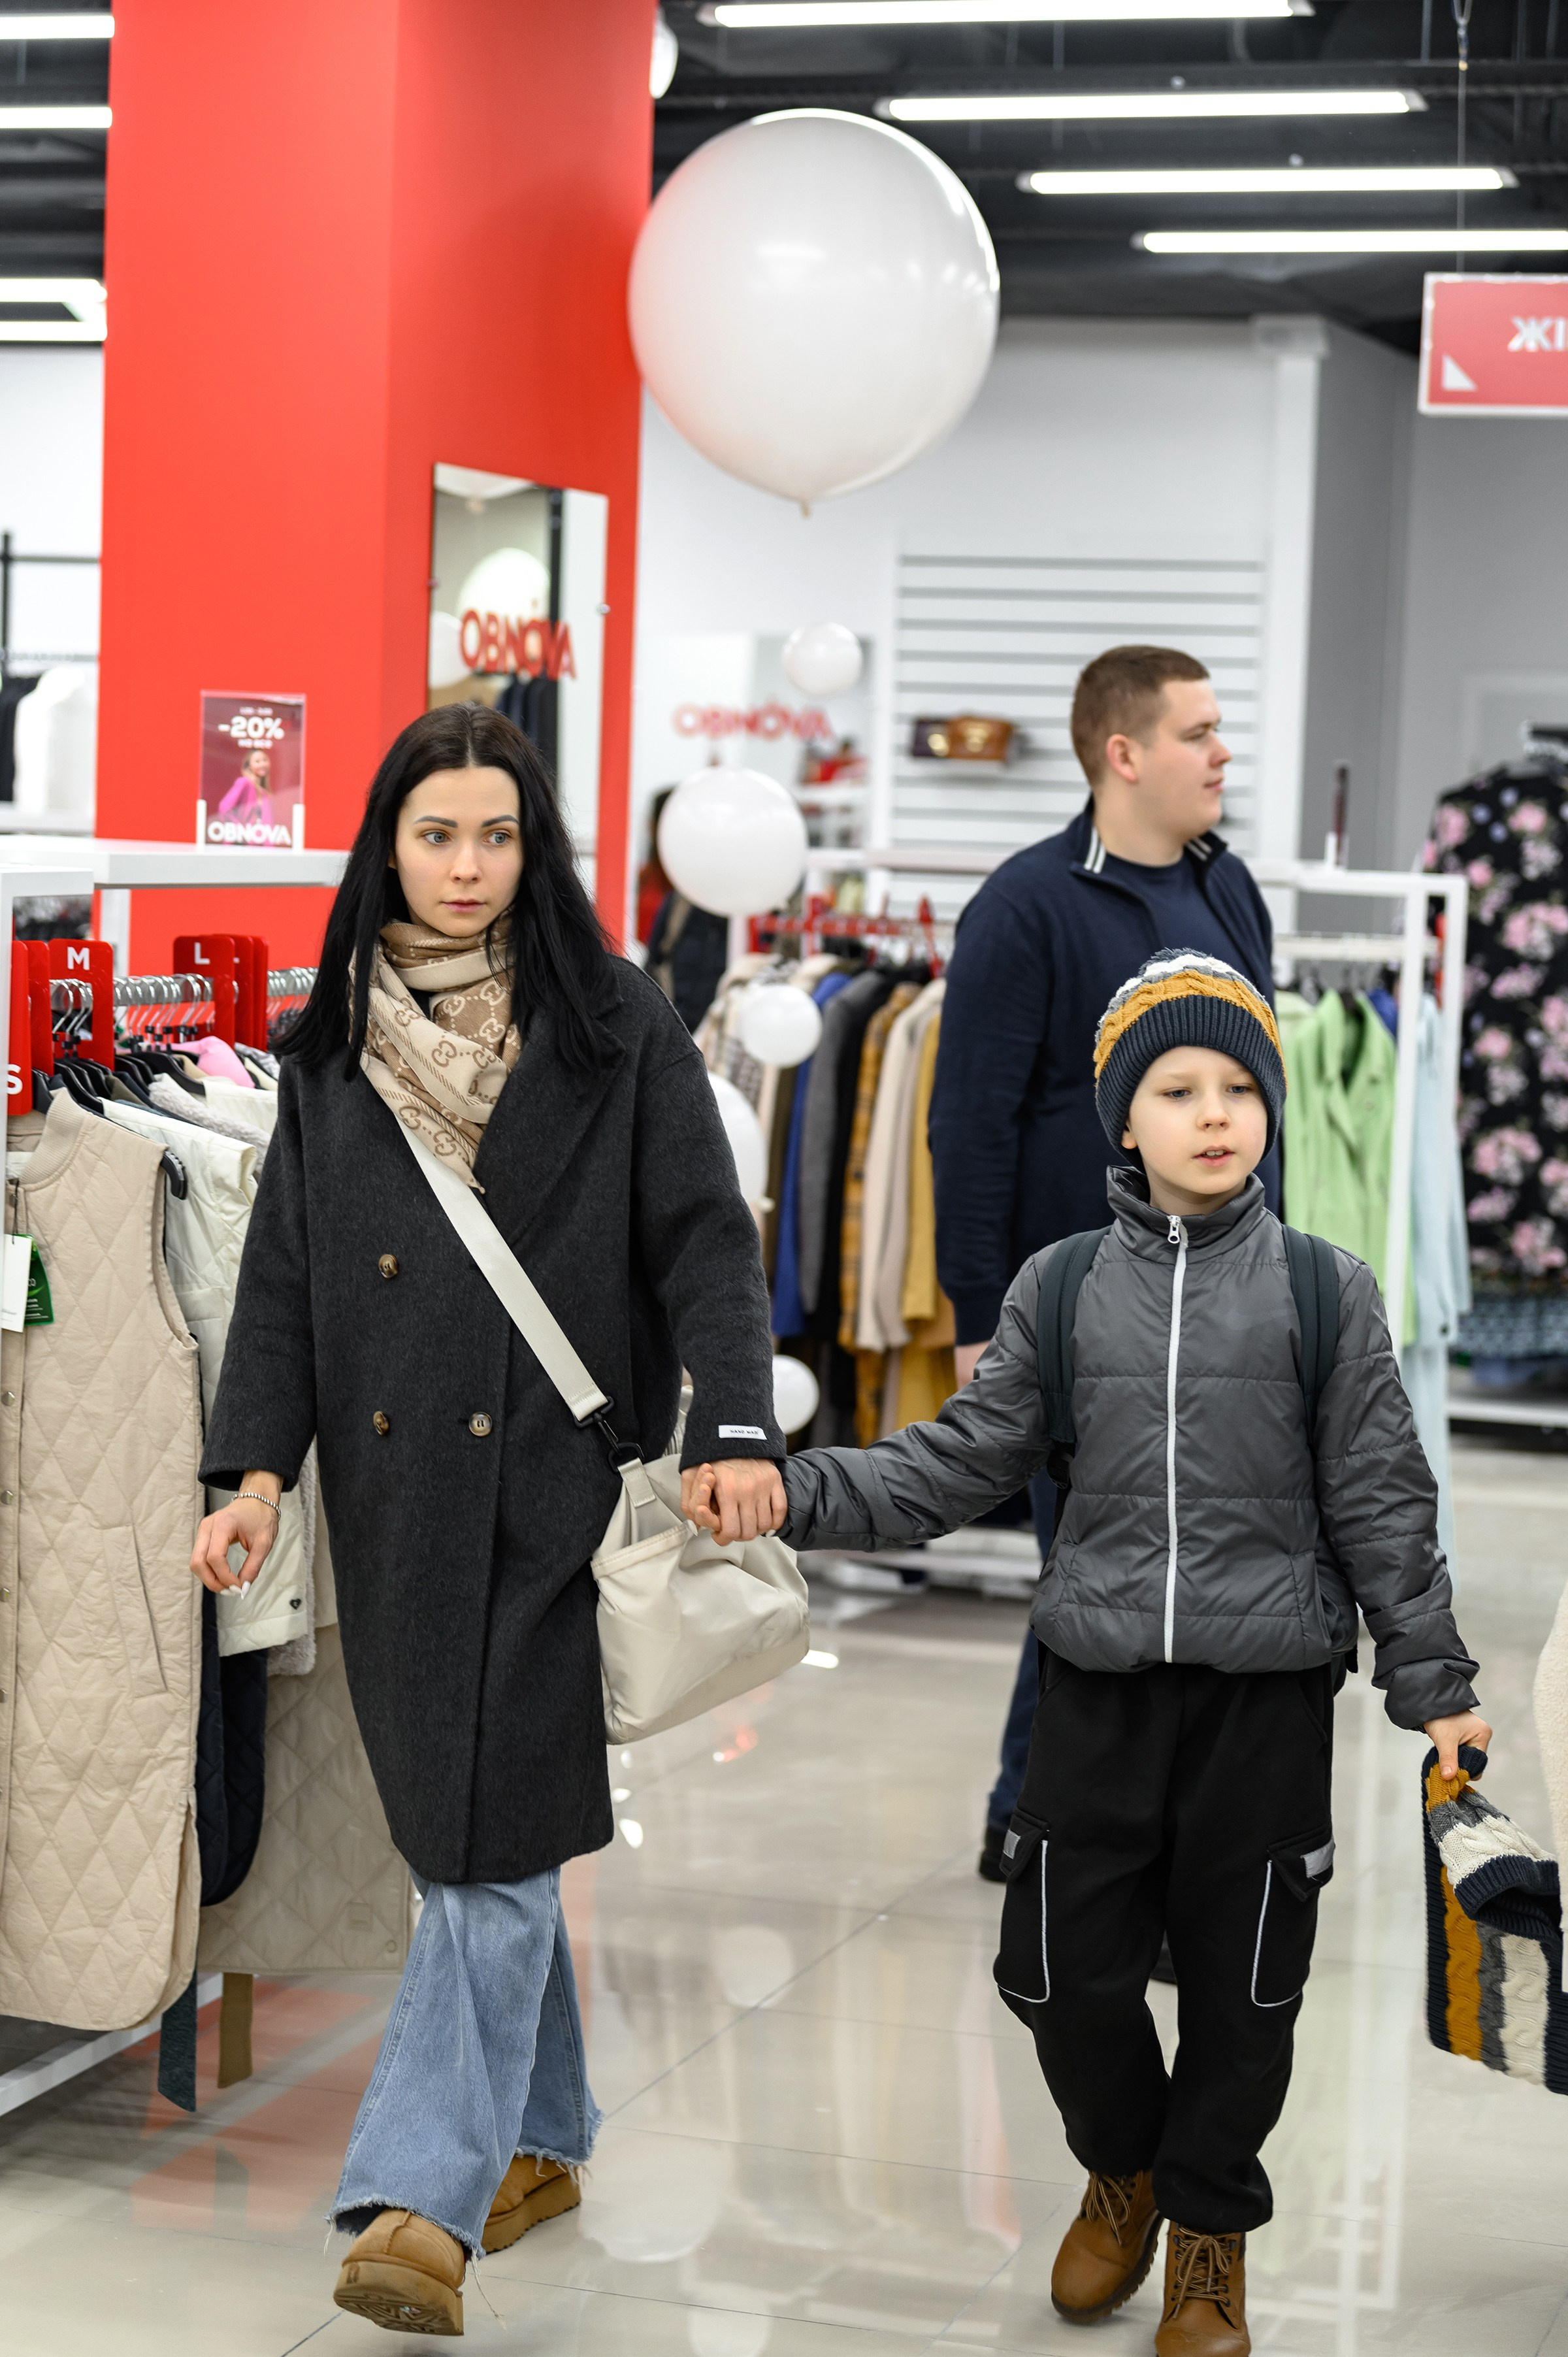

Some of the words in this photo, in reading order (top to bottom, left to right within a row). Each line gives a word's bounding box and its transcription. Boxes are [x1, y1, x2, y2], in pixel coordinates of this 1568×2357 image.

[1507, 316, 1568, 352] ЖІ
[461, 607, 577, 681] OBNOVA
[218, 716, 285, 740] -20%
[207, 820, 292, 846] OBNOVA
[67, 946, 90, 970] M
[194, 942, 210, 964] L
[7, 1063, 24, 1096] S
